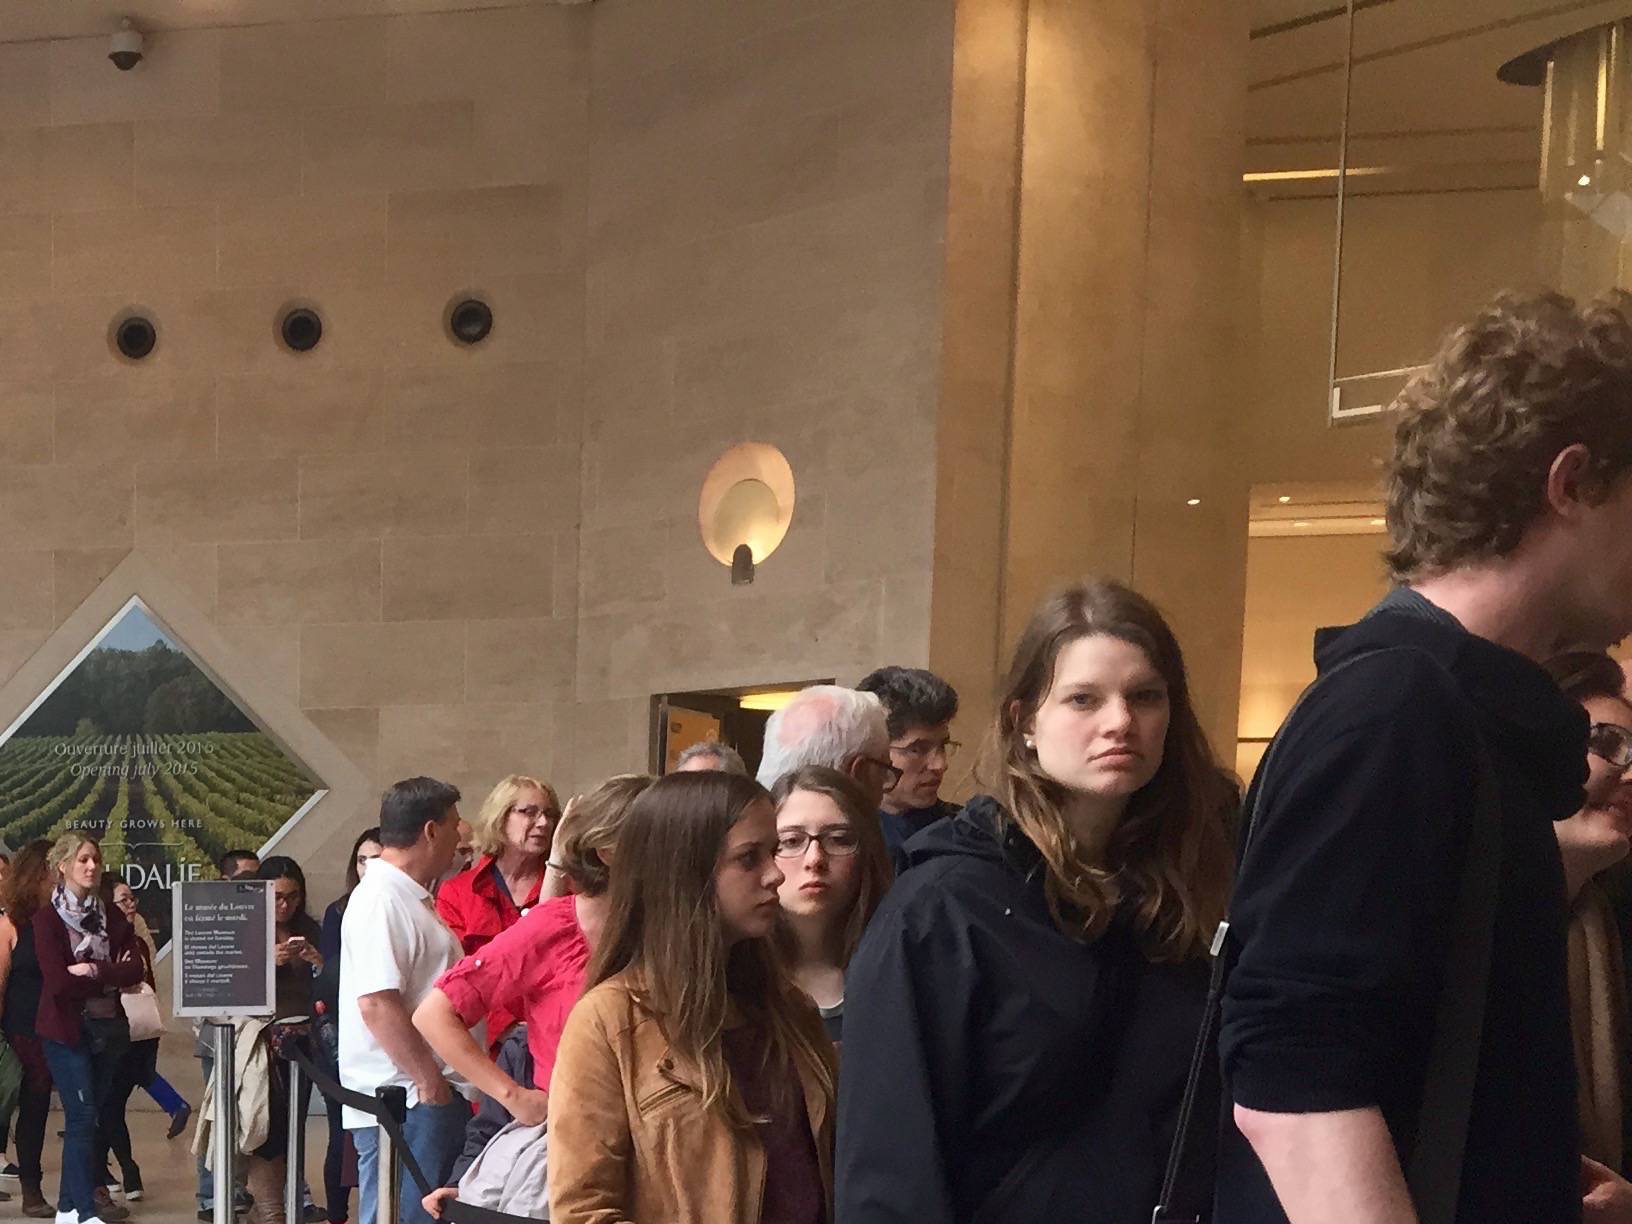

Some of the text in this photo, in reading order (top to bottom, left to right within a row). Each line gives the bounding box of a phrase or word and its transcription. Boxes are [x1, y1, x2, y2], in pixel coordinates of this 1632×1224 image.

[54, 742, 128, 756] Ouverture
[131, 741, 172, 758] juillet
[70, 761, 198, 780] Opening july 2015
[65, 819, 202, 829] BEAUTY GROWS HERE
